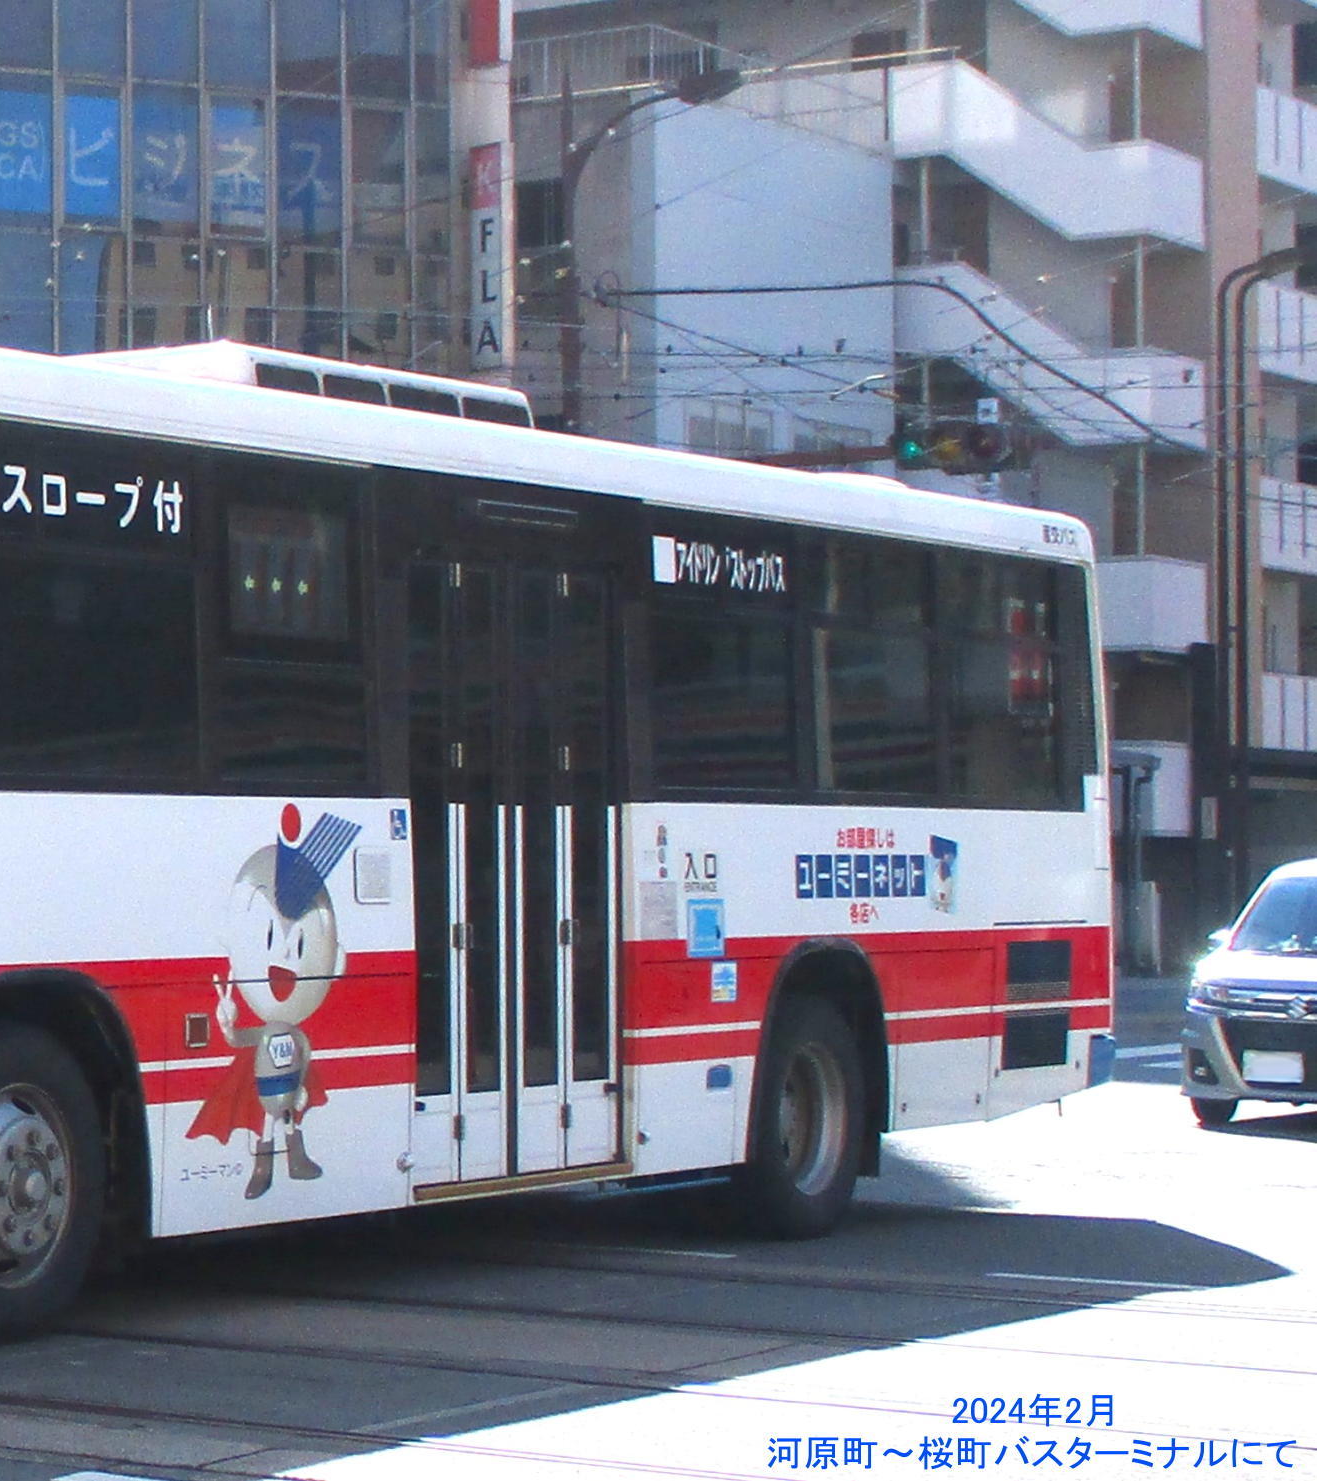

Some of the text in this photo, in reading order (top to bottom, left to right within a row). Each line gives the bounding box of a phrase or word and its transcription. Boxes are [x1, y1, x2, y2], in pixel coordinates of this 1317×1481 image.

[69, 128, 329, 200] ビジネス
[684, 852, 717, 879] 入口
[798, 860, 924, 891] ユーミーネット
